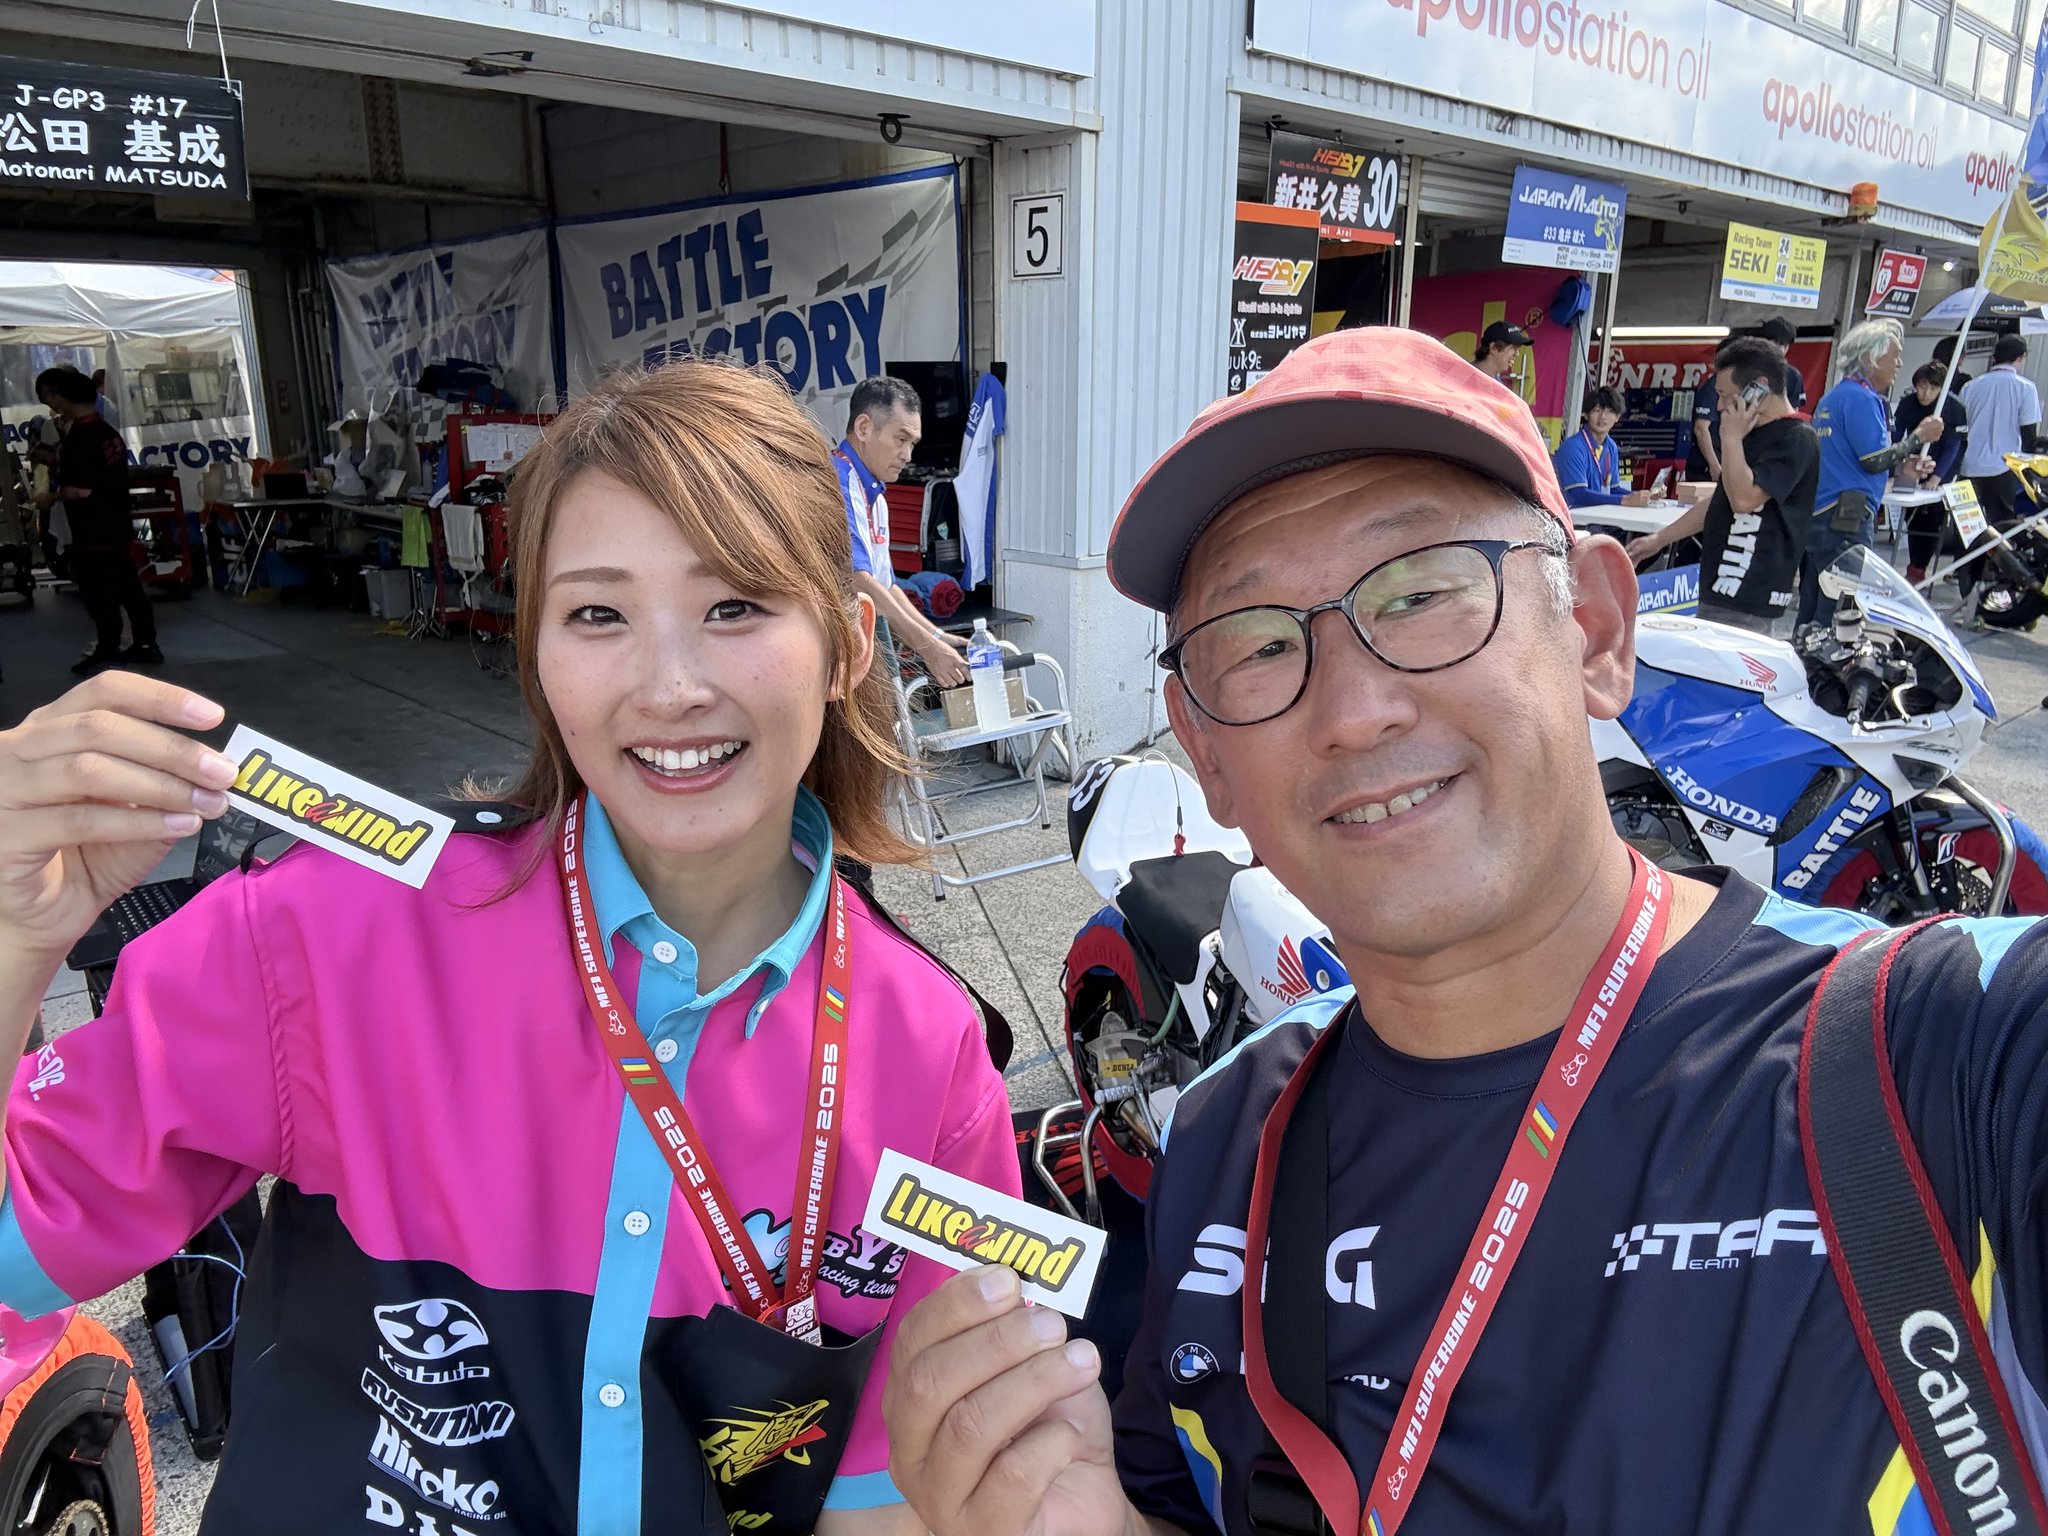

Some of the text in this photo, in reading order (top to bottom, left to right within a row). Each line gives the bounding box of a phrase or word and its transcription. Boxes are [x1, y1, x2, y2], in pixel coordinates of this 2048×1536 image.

[15, 84, 188, 119] J-GP3 #17
[1676, 38, 1712, 101] oil
[123, 119, 226, 169] 基成
[1762, 77, 1939, 171] apollostation oil
[105, 166, 227, 189] MATSUDA
[1363, 156, 1398, 230] 30
[1026, 205, 1049, 268] 5
[1728, 249, 1770, 274] SEKI
[1733, 232, 1772, 249] Racing Team
[1779, 238, 1790, 255] 24
[599, 207, 774, 340] BATTLE
[1776, 263, 1787, 279] 40
[1739, 678, 1778, 692] HONDA
[1667, 765, 1778, 833] HONDA
[564, 798, 578, 875] 2025
[1780, 785, 1883, 890] BATTLE
[567, 875, 599, 974] SUPERBIKE
[1597, 895, 1657, 1008] SUPERBIKE
[1260, 975, 1299, 1007] HOND
[815, 1043, 838, 1131] 2025
[653, 1105, 706, 1188] 2025
[803, 1134, 829, 1238] SUPERBIKE
[697, 1186, 750, 1273] SUPERBIKE
[862, 1279, 897, 1296] team
[1413, 1289, 1478, 1421] SUPERBIKE
[1468, 1177, 1530, 1293] 2025
[378, 1344, 490, 1385] Kabuto
[1176, 1345, 1213, 1365] BMW
[1900, 1309, 2017, 1536] Canon
[369, 1414, 500, 1515] Hiroko
[453, 1506, 508, 1521] RACING OIL
